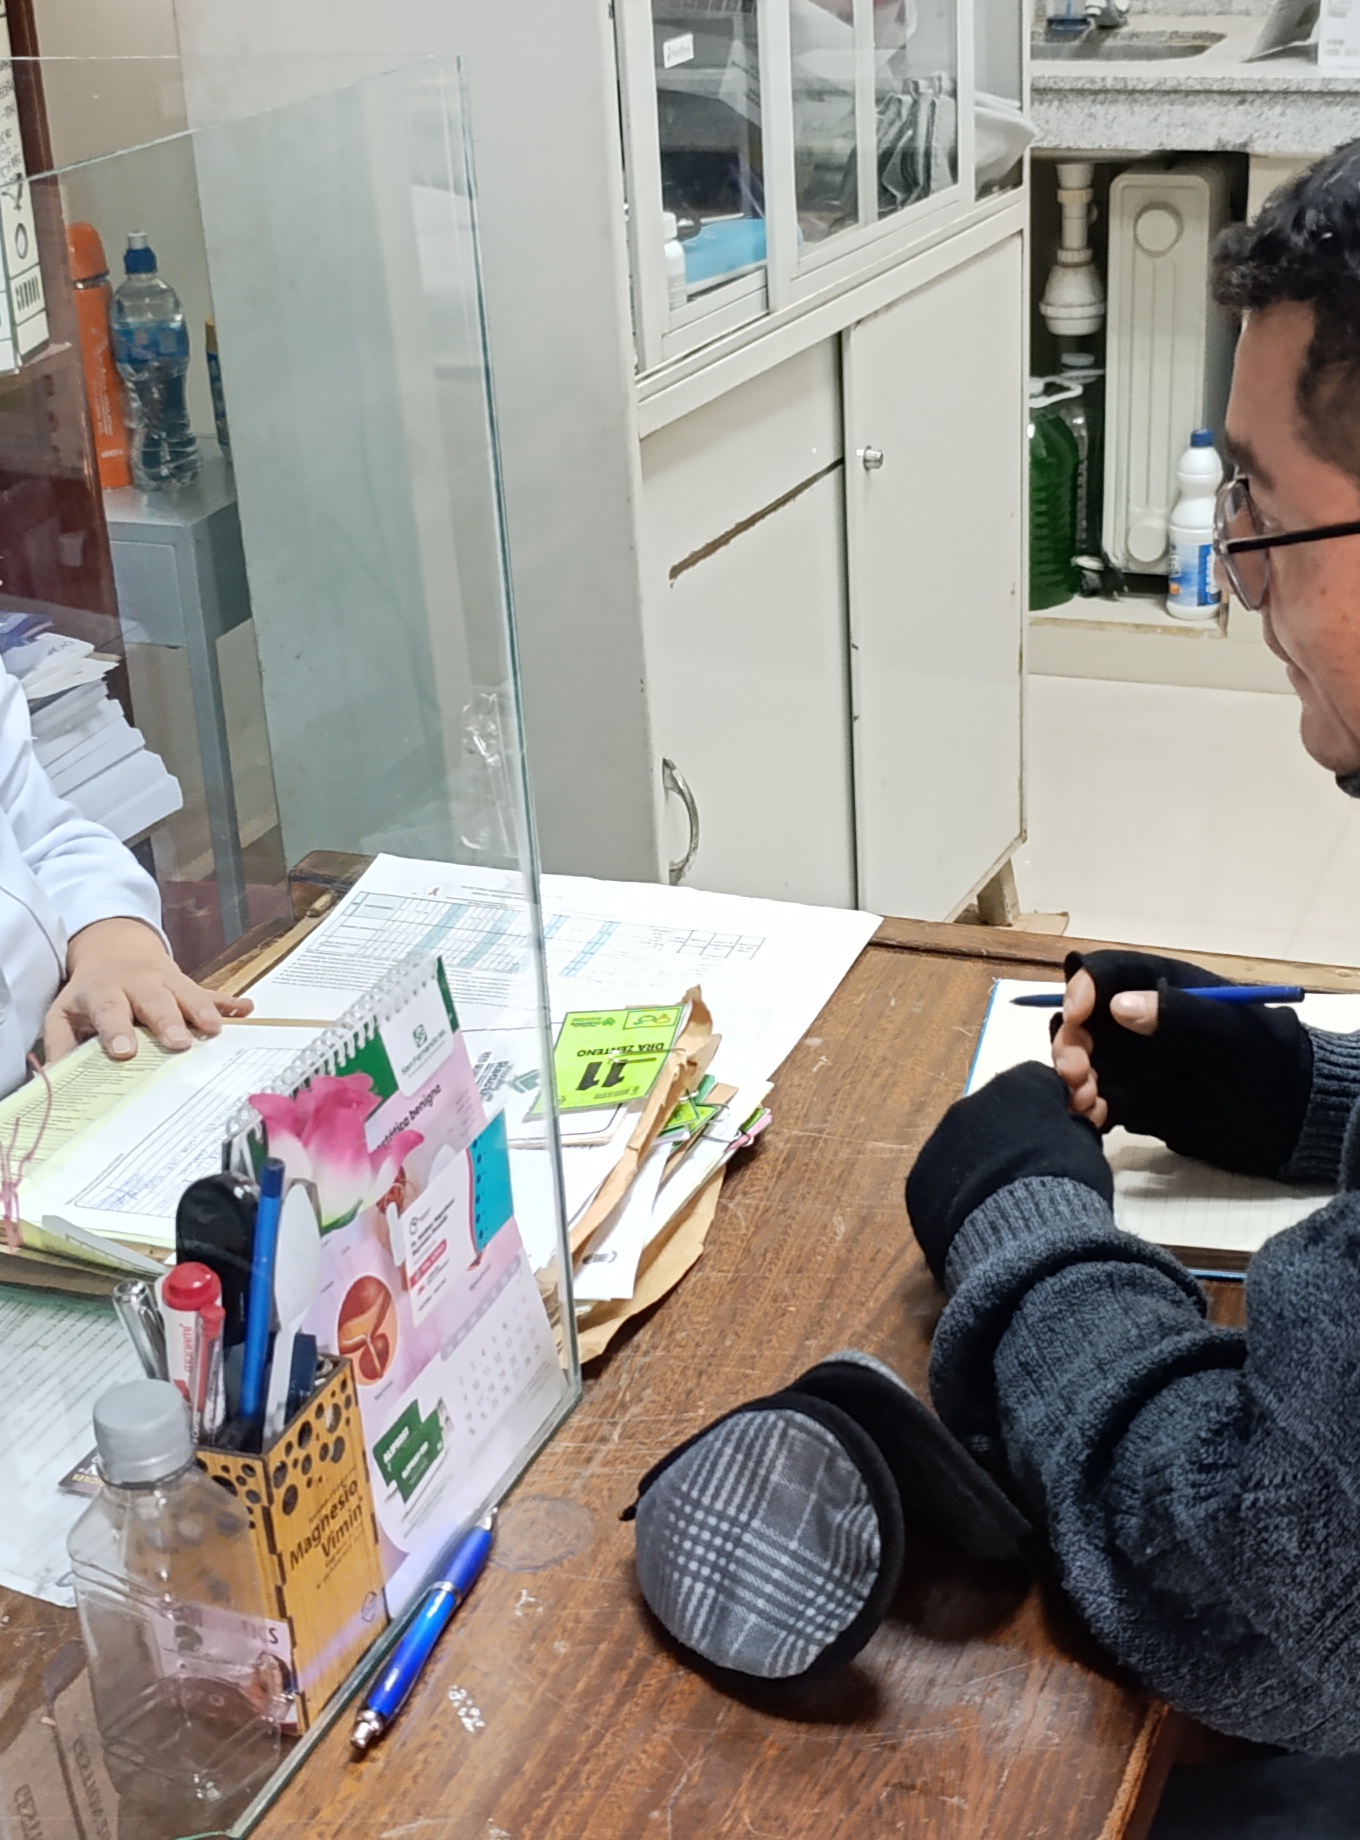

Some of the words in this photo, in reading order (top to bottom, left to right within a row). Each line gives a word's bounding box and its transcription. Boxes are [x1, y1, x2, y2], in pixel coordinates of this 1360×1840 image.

[576, 1059, 628, 1091] 11
[408, 1083, 442, 1121] benigna
[289, 1479, 360, 1571] Magnesio
[321, 1504, 363, 1559] Vimin
